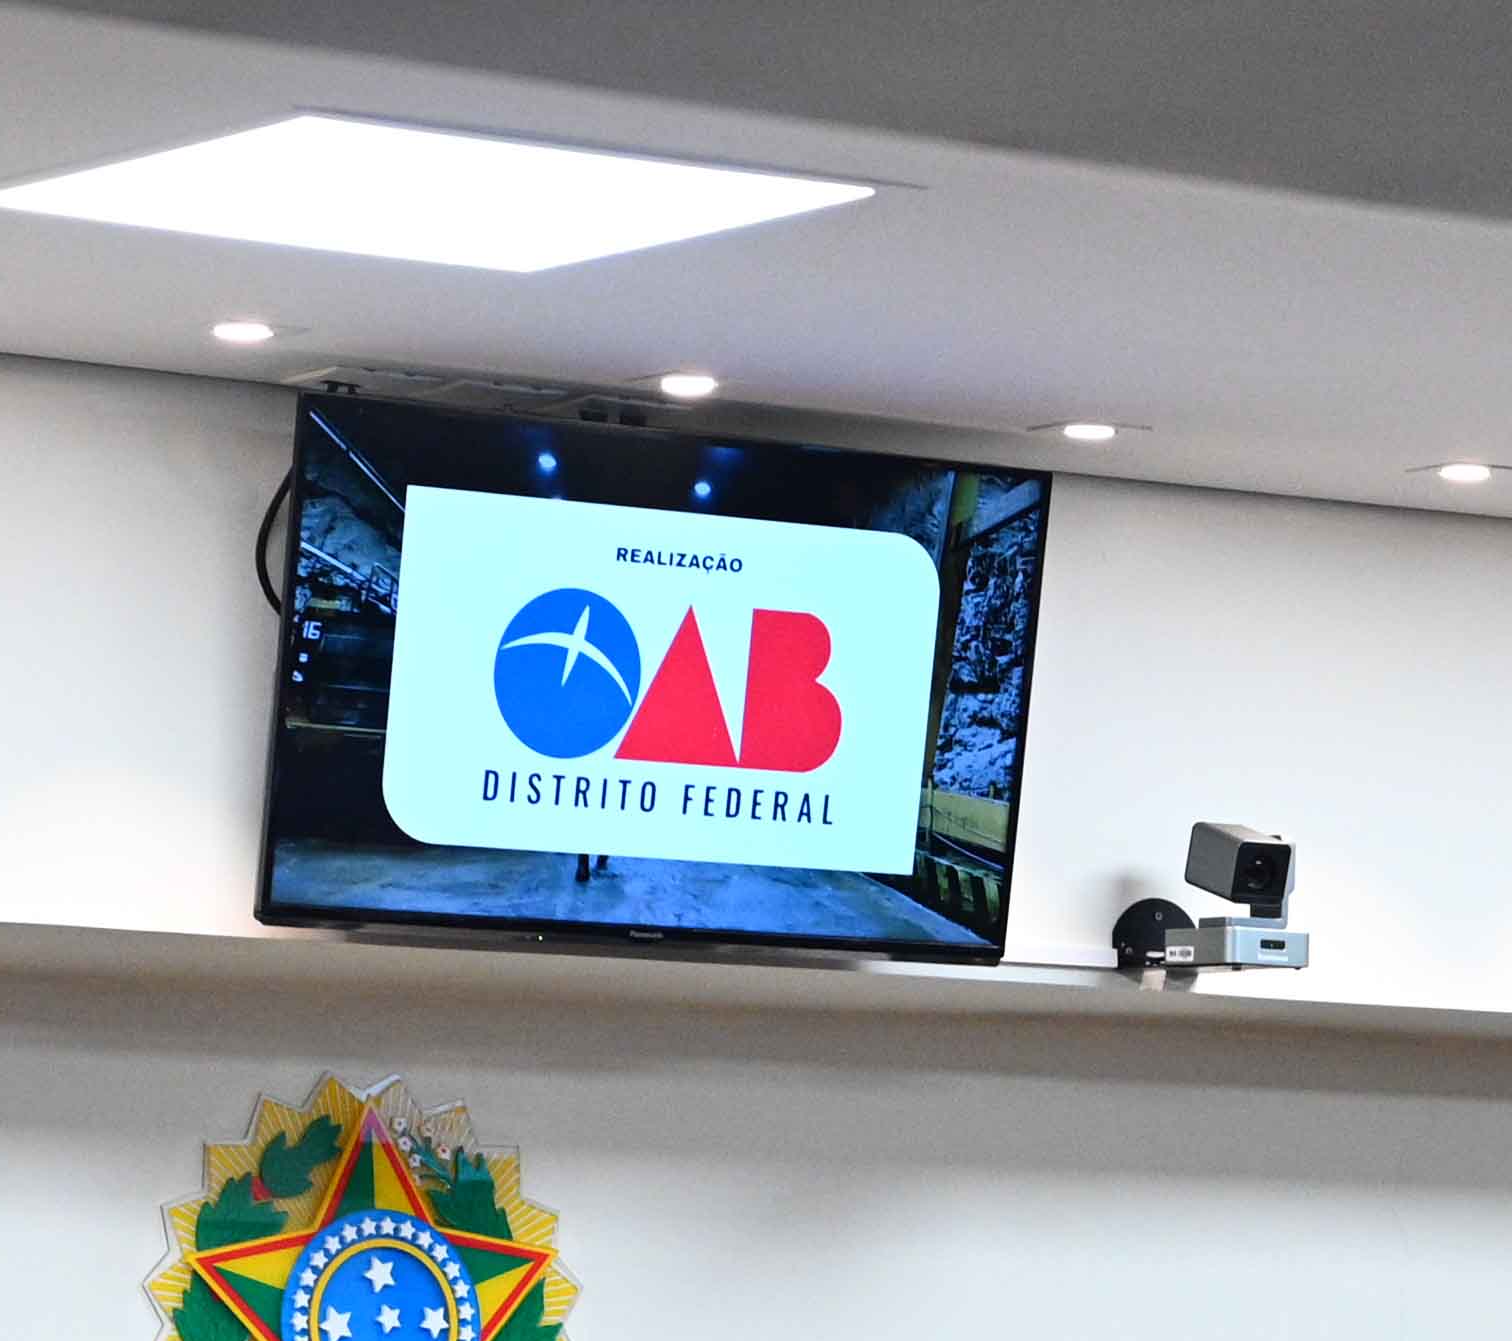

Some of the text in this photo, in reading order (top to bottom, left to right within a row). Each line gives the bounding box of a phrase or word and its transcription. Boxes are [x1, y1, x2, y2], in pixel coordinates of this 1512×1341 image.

[616, 547, 744, 574] REALIZAÇÃO
[493, 587, 843, 774] OAB
[482, 769, 834, 825] DISTRITO FEDERAL
